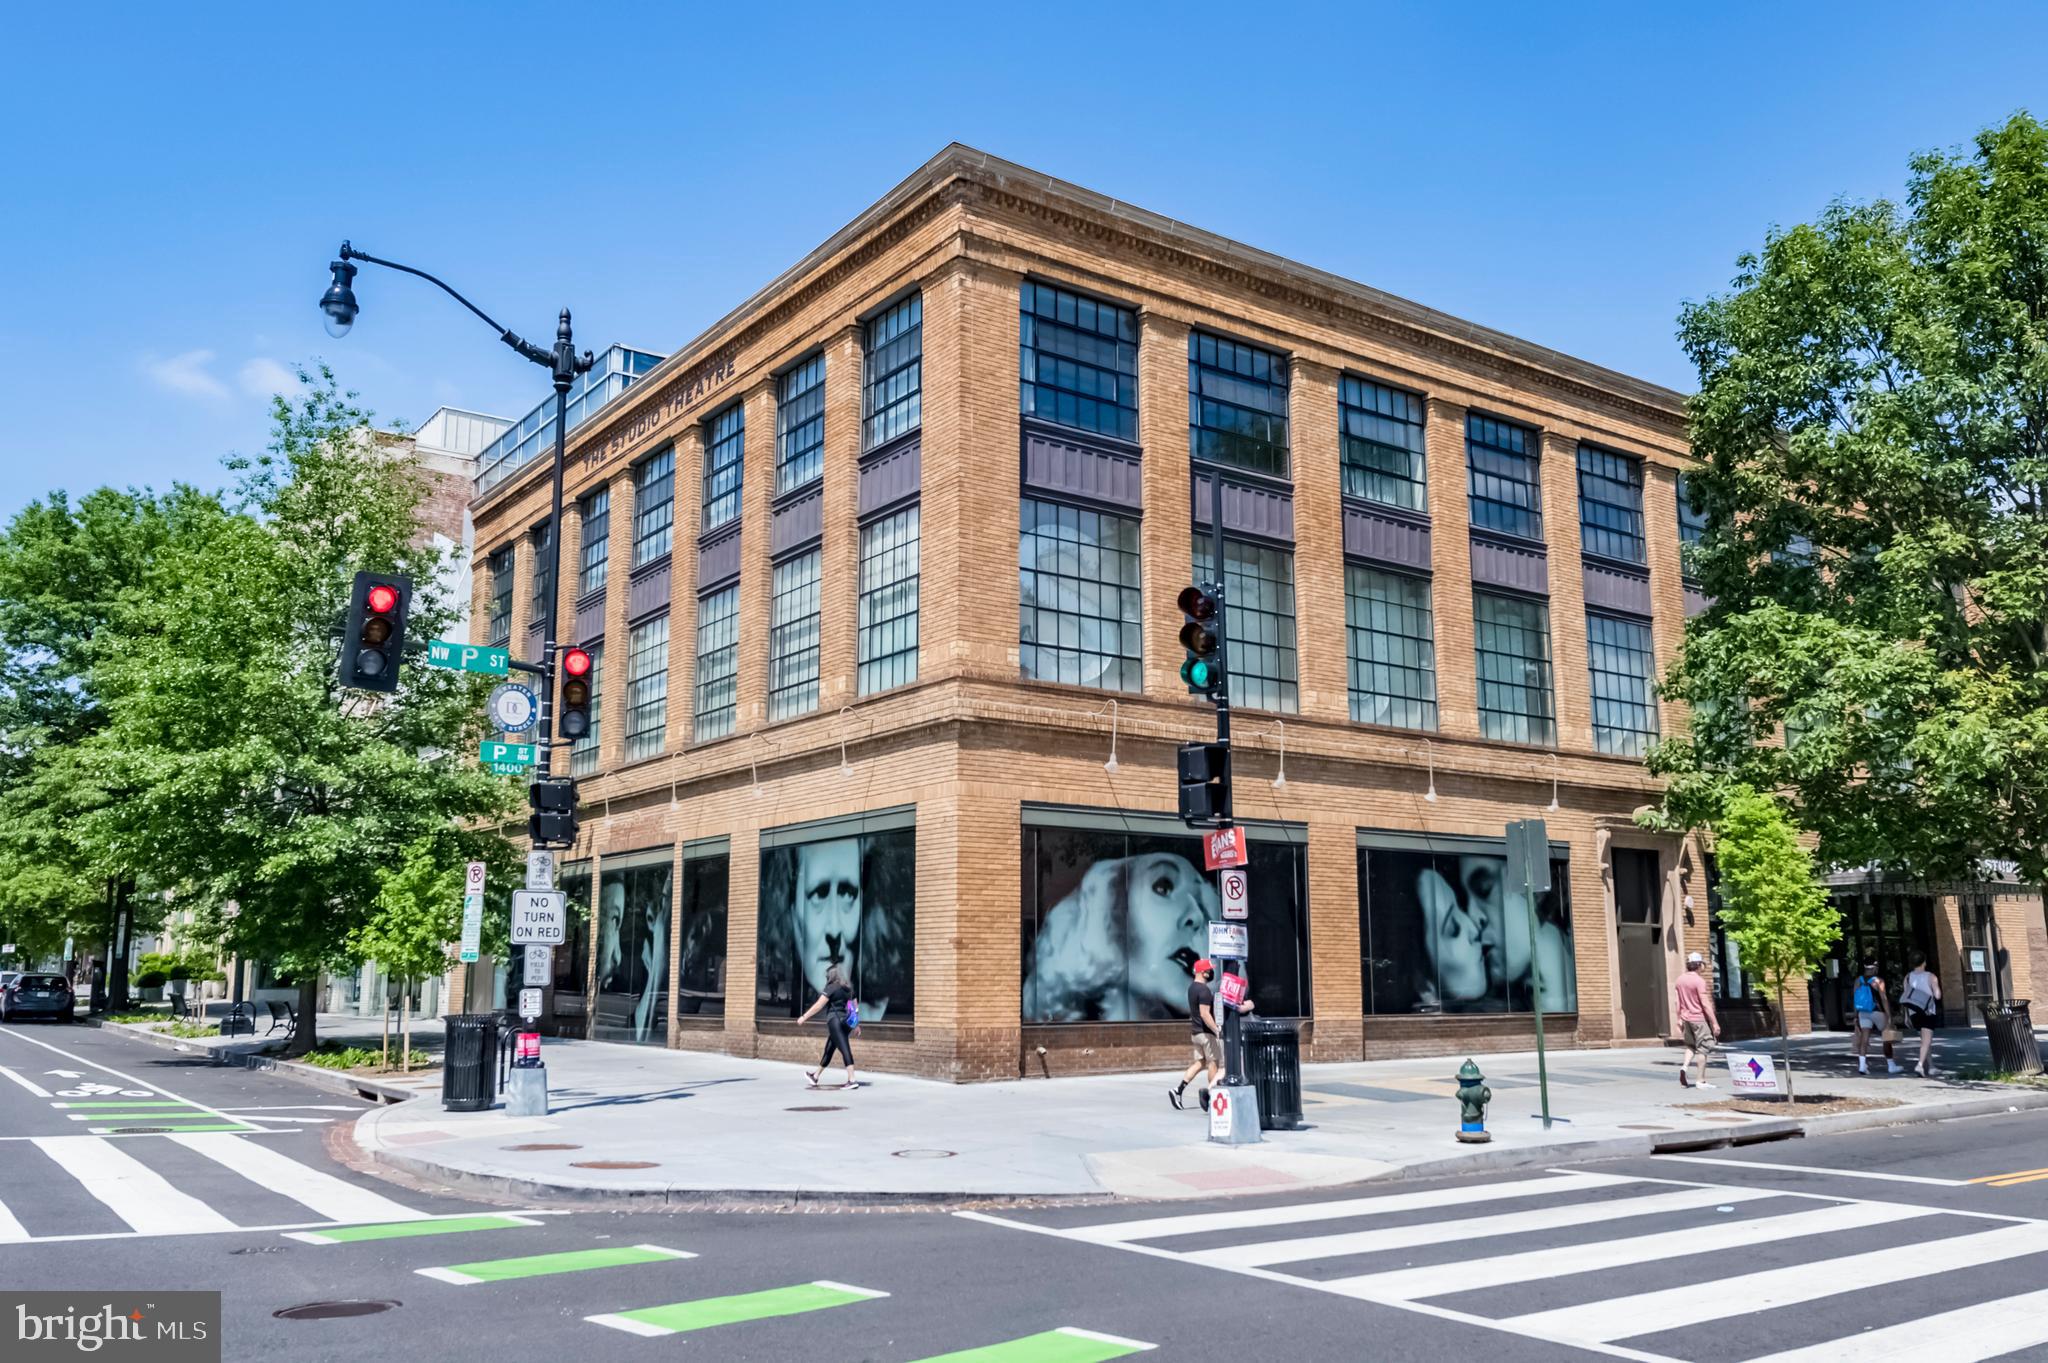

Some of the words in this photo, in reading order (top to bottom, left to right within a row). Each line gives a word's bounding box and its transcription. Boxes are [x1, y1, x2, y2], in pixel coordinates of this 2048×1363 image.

[584, 447, 607, 472] THE
[611, 412, 661, 455] STUDIO
[666, 361, 736, 418] THEATRE
[431, 646, 450, 661] NW
[461, 647, 479, 668] P
[489, 654, 506, 668] ST
[507, 716, 535, 732] STREET
[493, 745, 508, 760] P
[518, 747, 529, 755] ST
[493, 763, 523, 773] 1400
[1211, 829, 1236, 860] EVANS
[530, 897, 549, 908] NO
[524, 911, 555, 923] TURN
[516, 926, 533, 938] ON
[537, 926, 560, 938] RED
[1212, 926, 1228, 935] JOHN
